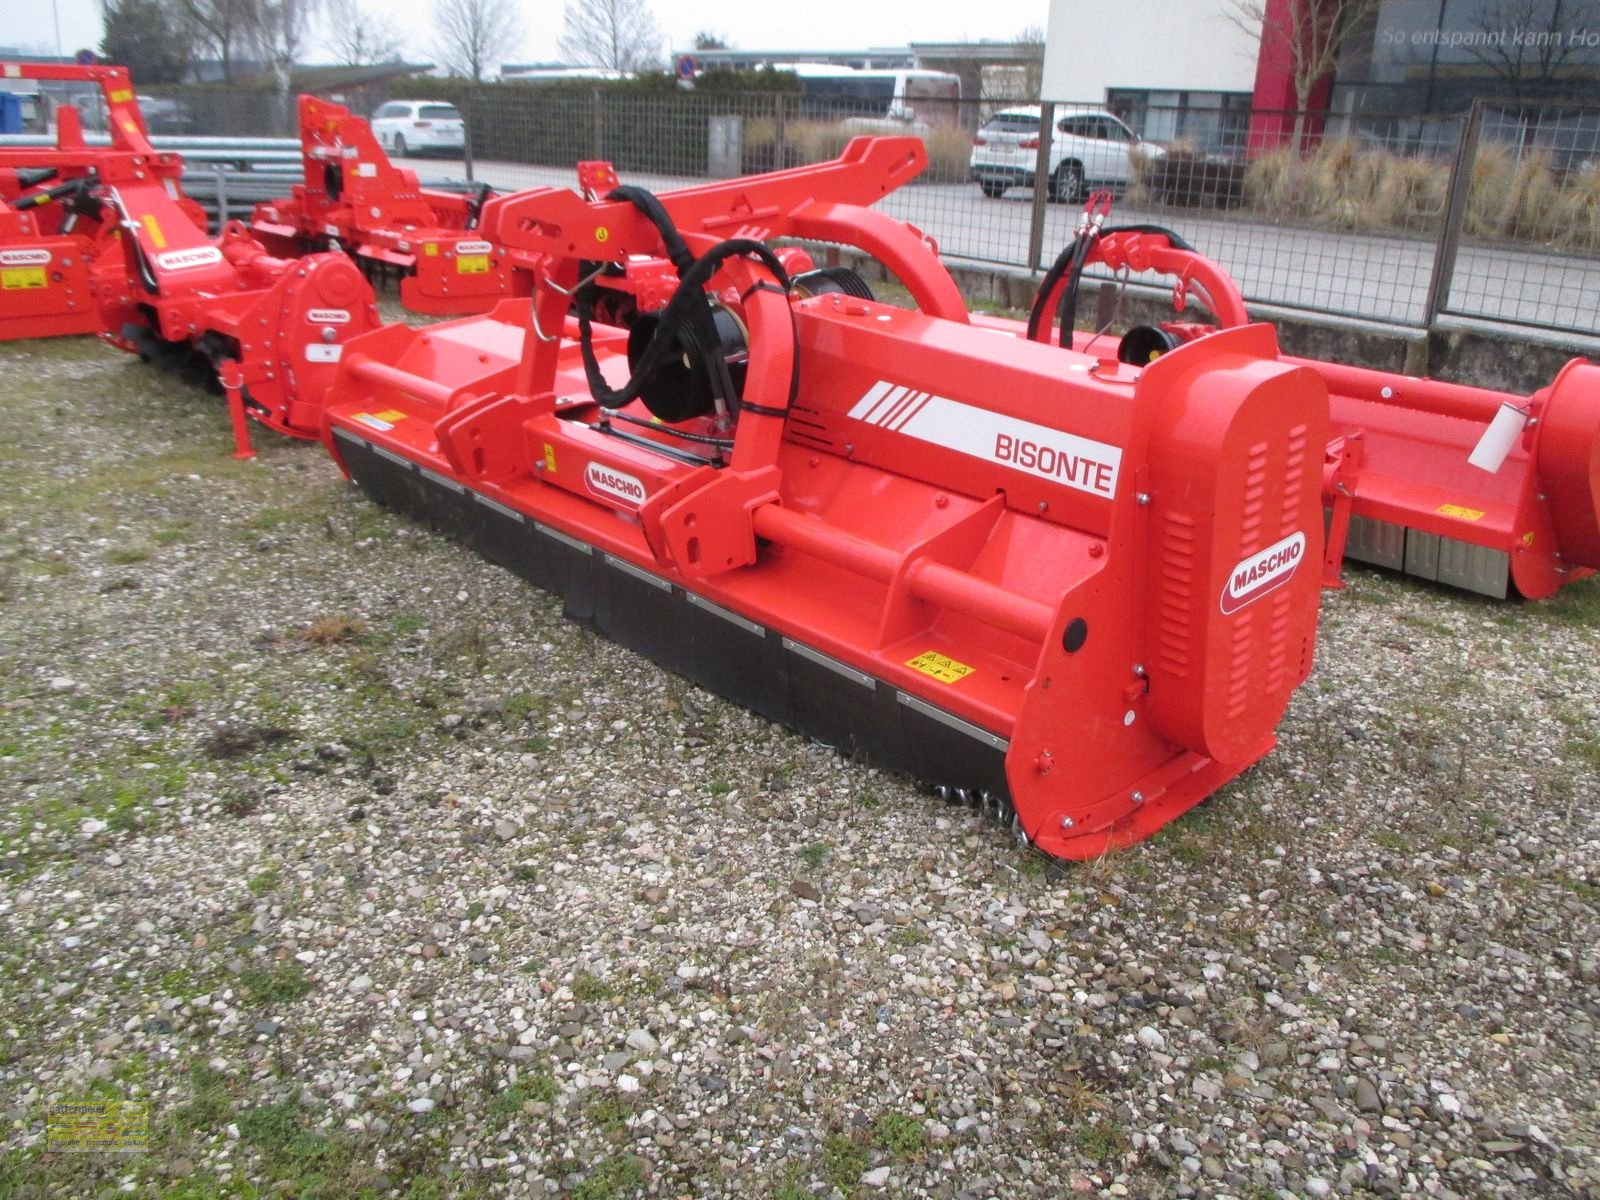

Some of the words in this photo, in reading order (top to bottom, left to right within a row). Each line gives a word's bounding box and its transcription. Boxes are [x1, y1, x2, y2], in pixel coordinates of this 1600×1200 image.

[1382, 28, 1406, 45] So
[1411, 28, 1507, 48] entspannt
[1512, 27, 1561, 46] kann
[163, 251, 216, 265] MASCHIO
[994, 432, 1114, 493] BISONTE
[591, 469, 643, 499] MASCHIO
[1233, 540, 1302, 593] MASCHIO
